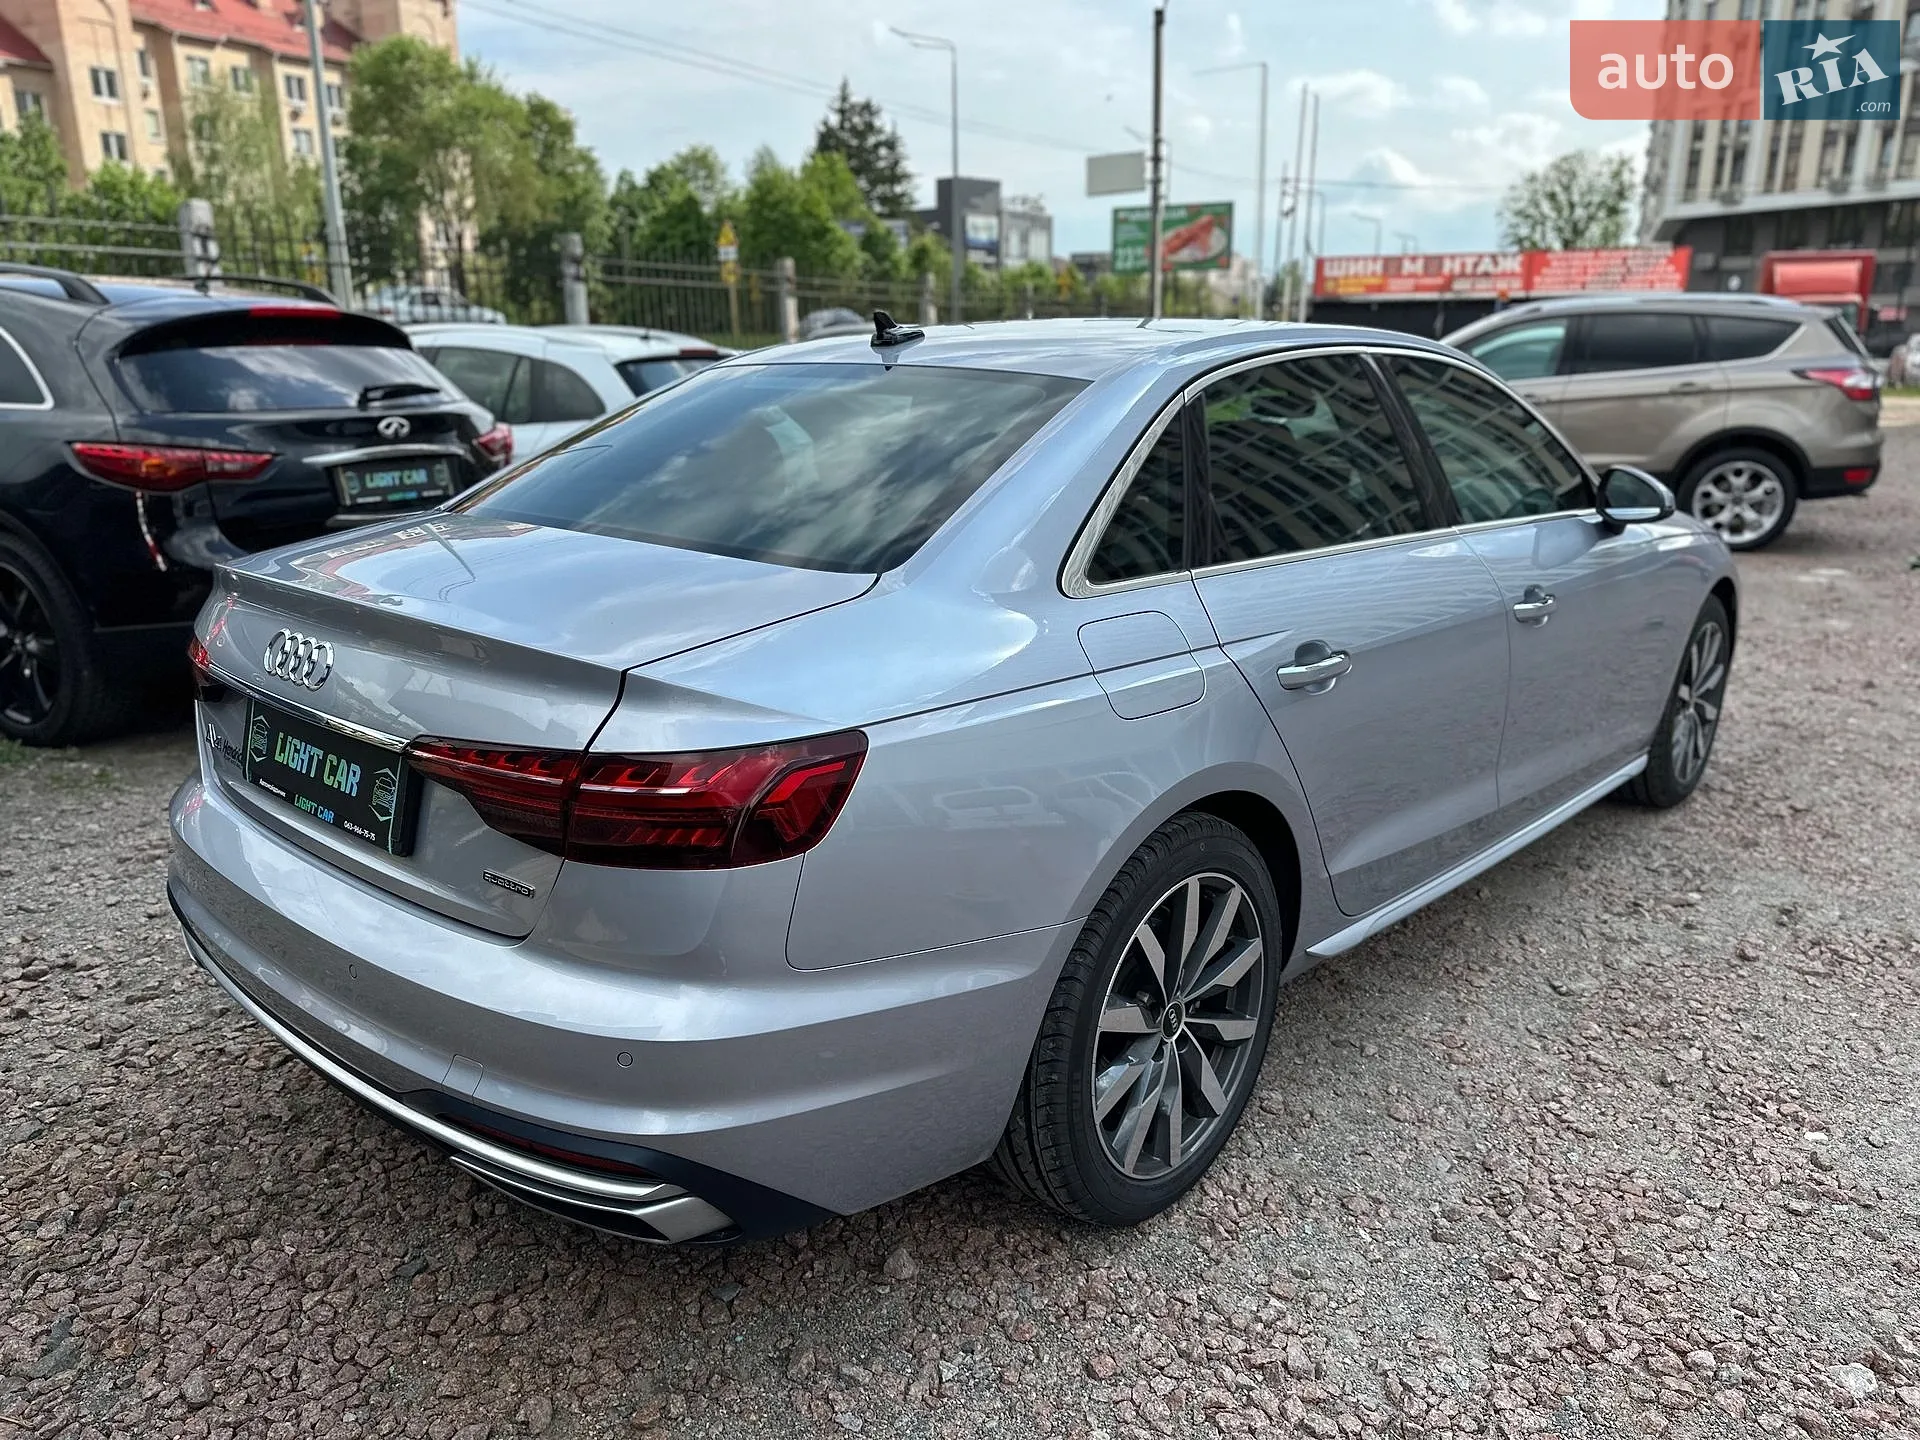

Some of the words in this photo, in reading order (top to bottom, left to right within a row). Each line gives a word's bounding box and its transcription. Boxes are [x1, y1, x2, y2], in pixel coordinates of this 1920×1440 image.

[1323, 254, 1522, 277] ШИНМНТАЖ
[274, 731, 324, 778] LIGHT
[323, 753, 361, 797] CAR
[294, 794, 318, 815] LIGHT
[317, 805, 335, 824] CAR
[483, 872, 529, 896] quattro
